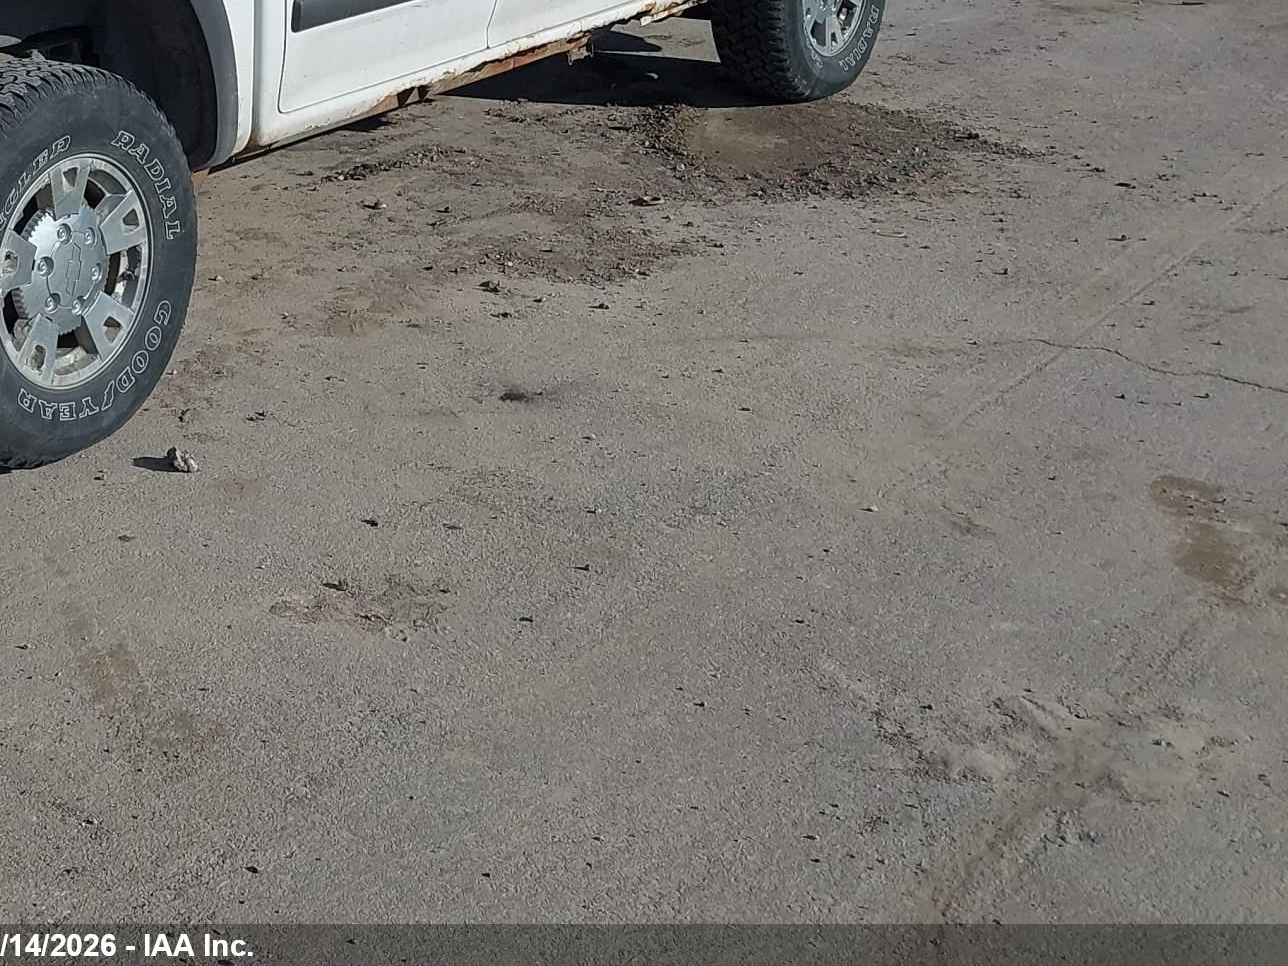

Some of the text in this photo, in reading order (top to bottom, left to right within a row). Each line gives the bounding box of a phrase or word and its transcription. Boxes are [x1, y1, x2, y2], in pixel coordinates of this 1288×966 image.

[839, 4, 880, 71] RADIAL
[111, 130, 184, 240] RADIAL
[17, 300, 172, 421] GOODYEAR
